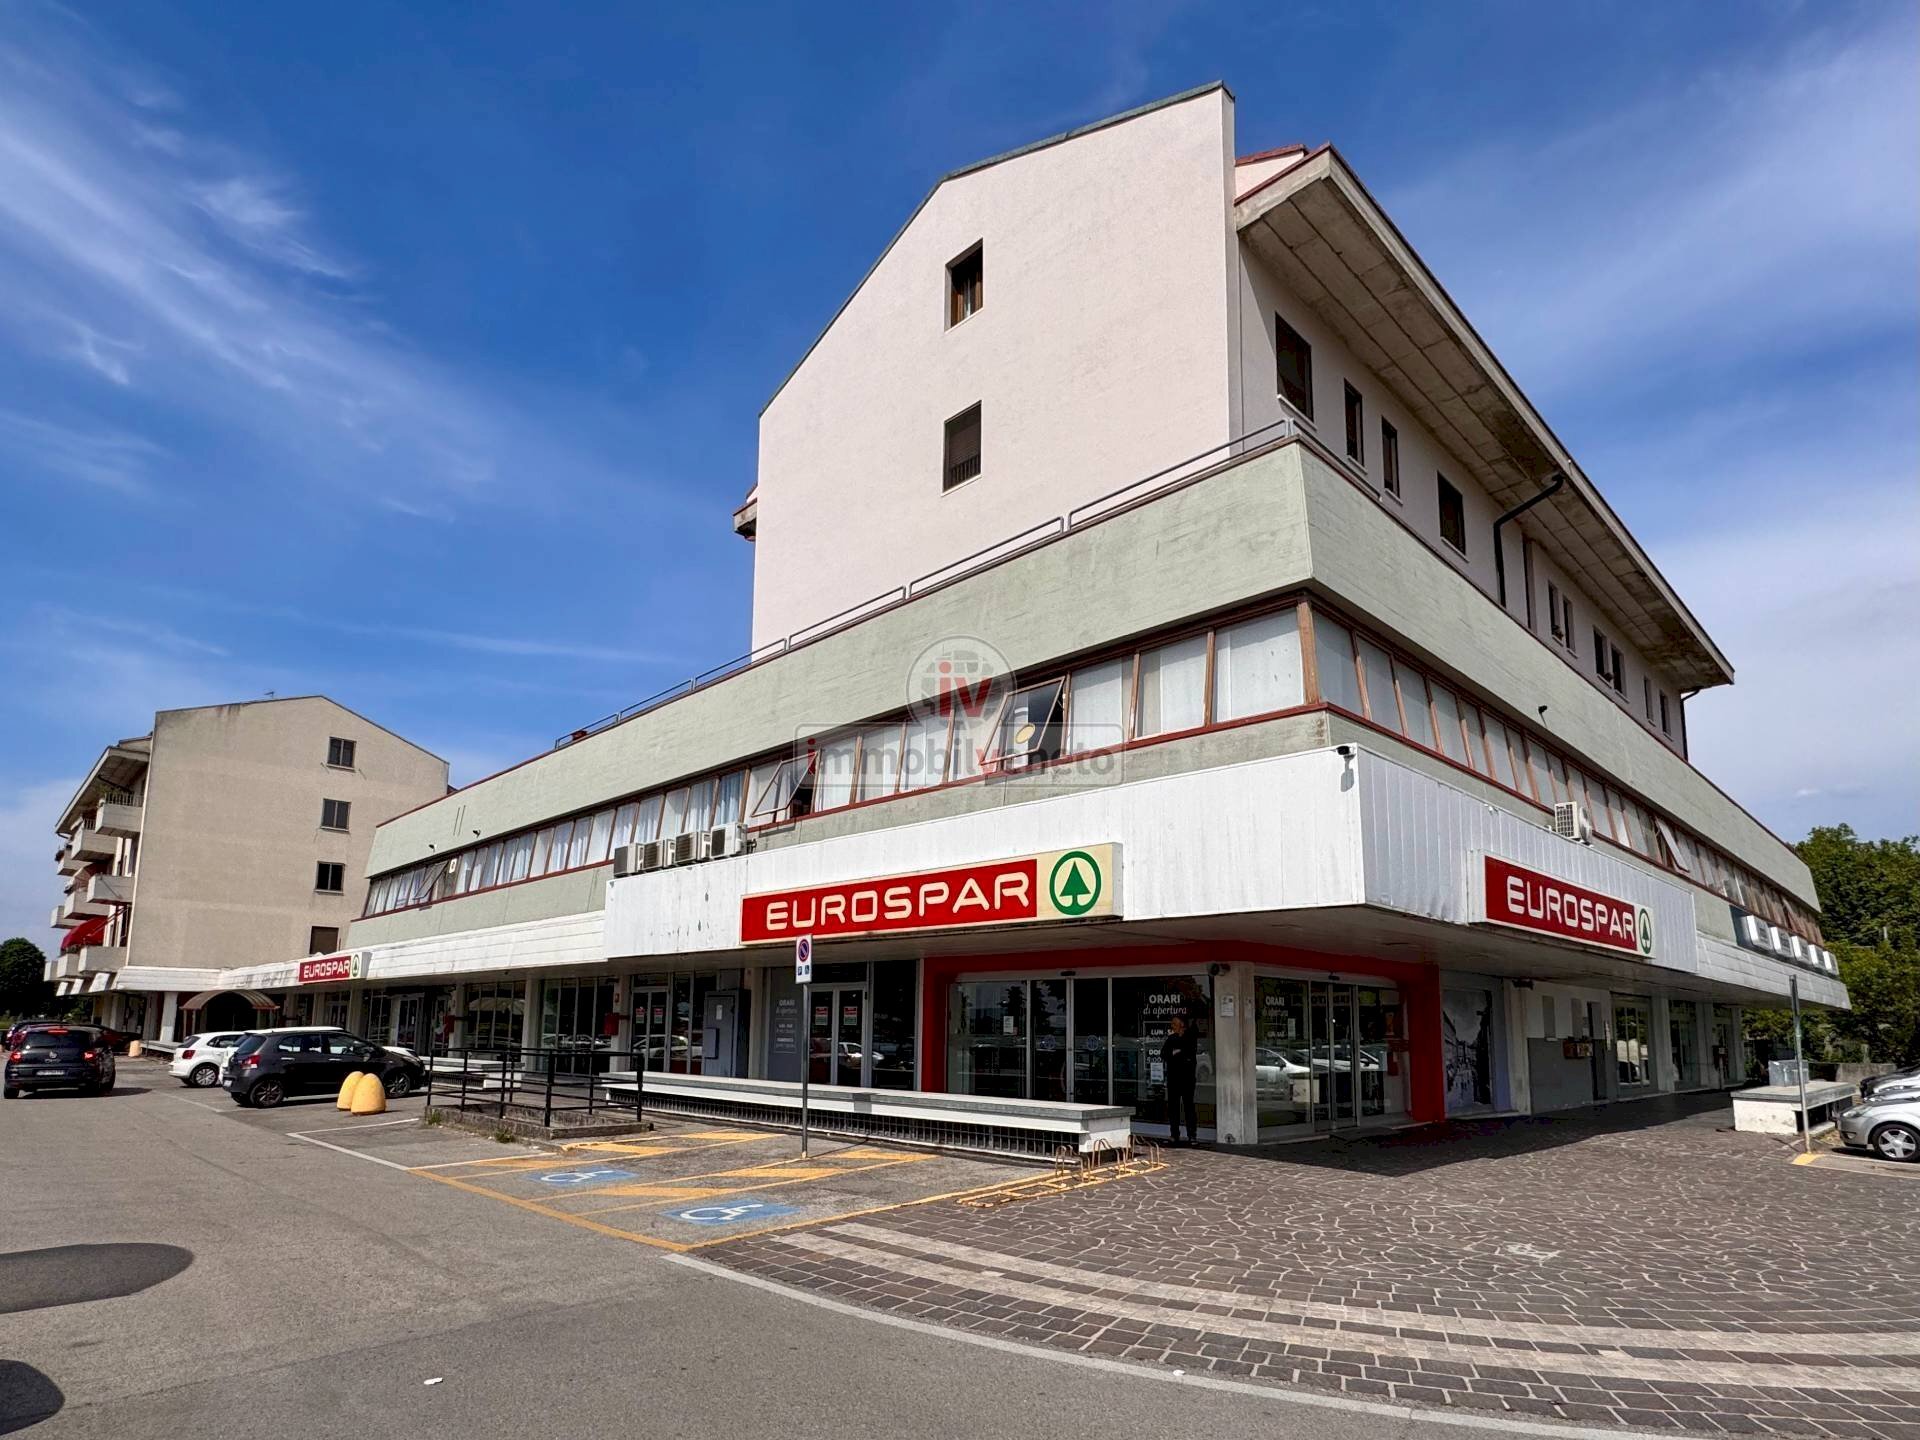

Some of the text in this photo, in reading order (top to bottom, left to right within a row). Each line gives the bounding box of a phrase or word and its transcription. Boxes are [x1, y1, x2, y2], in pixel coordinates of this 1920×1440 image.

[766, 871, 1030, 931] EUROSPAR
[1506, 875, 1635, 942] EUROSPAR
[303, 960, 350, 979] EUROSPAR
[1148, 994, 1181, 1004] ORARI
[1143, 1004, 1188, 1019] di apertura
